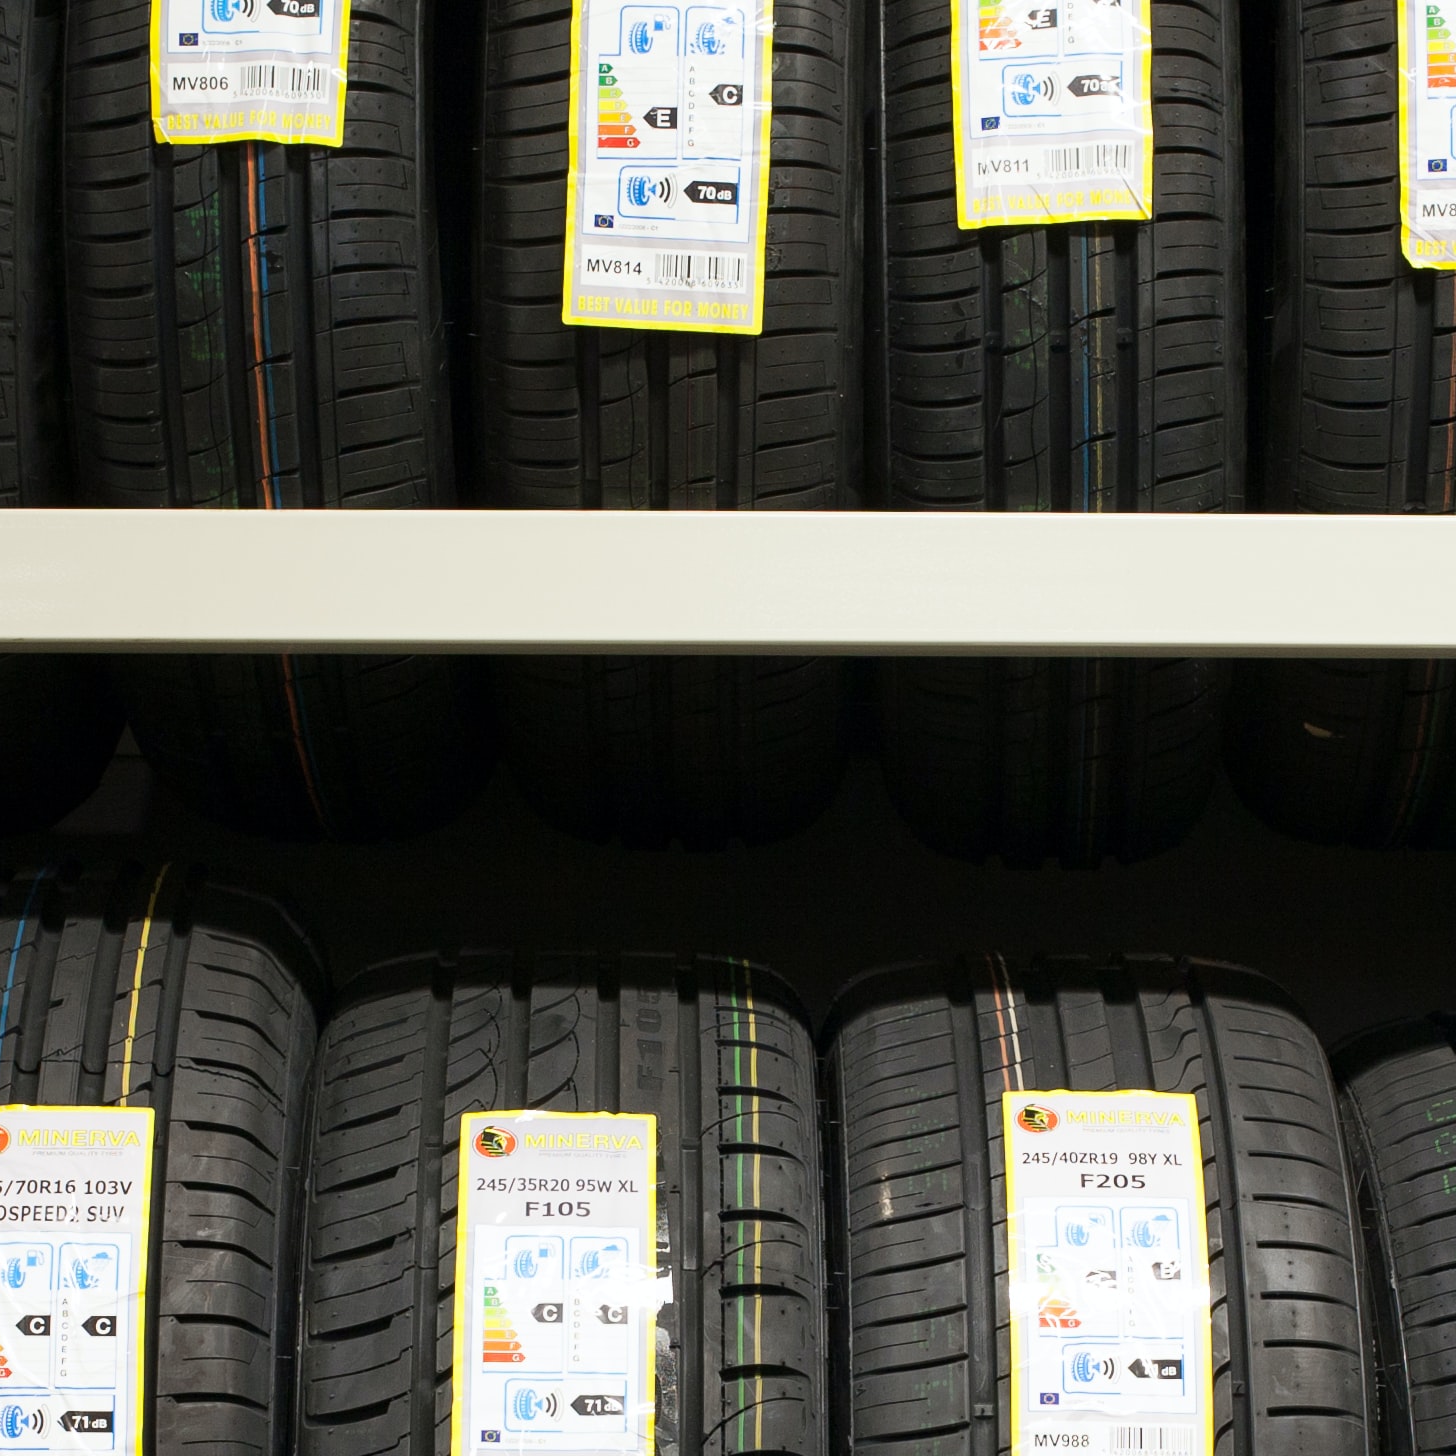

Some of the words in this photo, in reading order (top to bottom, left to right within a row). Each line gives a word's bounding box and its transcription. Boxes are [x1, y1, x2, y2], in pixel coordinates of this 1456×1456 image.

[173, 76, 229, 91] MV806
[722, 86, 738, 104] C
[656, 109, 671, 127] E
[586, 258, 642, 275] MV814
[577, 296, 611, 312] BEST
[615, 297, 658, 316] VALUE
[664, 300, 692, 317] FOR
[697, 303, 749, 321] MONEY
[1066, 1109, 1186, 1126] MINERVA
[18, 1129, 141, 1147] MINERVA
[524, 1133, 643, 1150] MINERVA
[1022, 1152, 1118, 1166] 245/40ZR19
[1128, 1152, 1158, 1166] 98Y
[1163, 1153, 1182, 1166] XL
[84, 1180, 133, 1195] 103V
[476, 1177, 570, 1193] 245/35R20
[575, 1178, 612, 1193] 95W
[618, 1179, 638, 1193] XL
[1081, 1174, 1146, 1189] F205
[87, 1205, 125, 1222] SUV
[525, 1201, 591, 1217] F105
[543, 1305, 559, 1321] C
[29, 1317, 45, 1334] C
[95, 1318, 111, 1335] C
[1034, 1434, 1090, 1448] MV988
